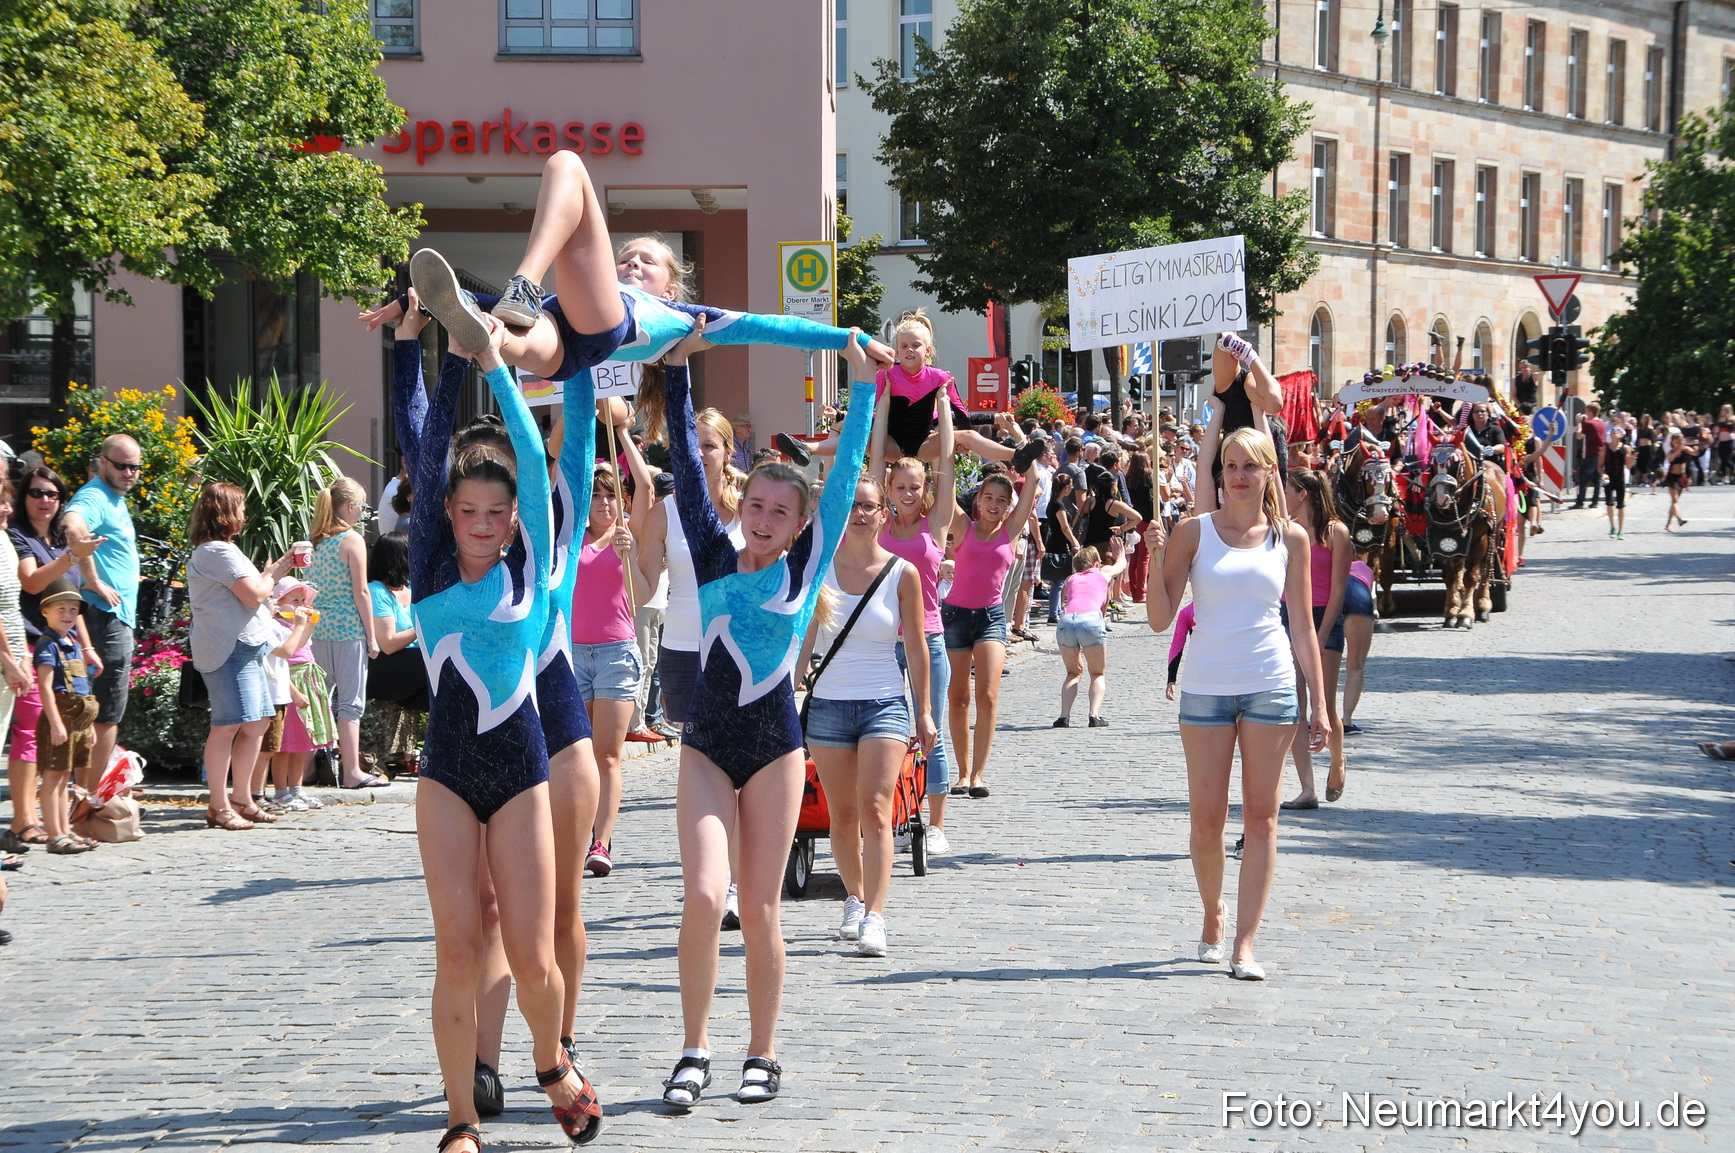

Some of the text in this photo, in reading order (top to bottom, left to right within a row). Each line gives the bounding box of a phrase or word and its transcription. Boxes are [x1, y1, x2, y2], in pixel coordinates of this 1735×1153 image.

[382, 108, 645, 165] Sparkasse
[797, 258, 817, 282] H
[1067, 249, 1246, 299] WELTGYMNASTRADA
[1182, 288, 1244, 328] 2015
[1360, 385, 1408, 393] Circusverein
[1408, 385, 1446, 394] Neumarkt
